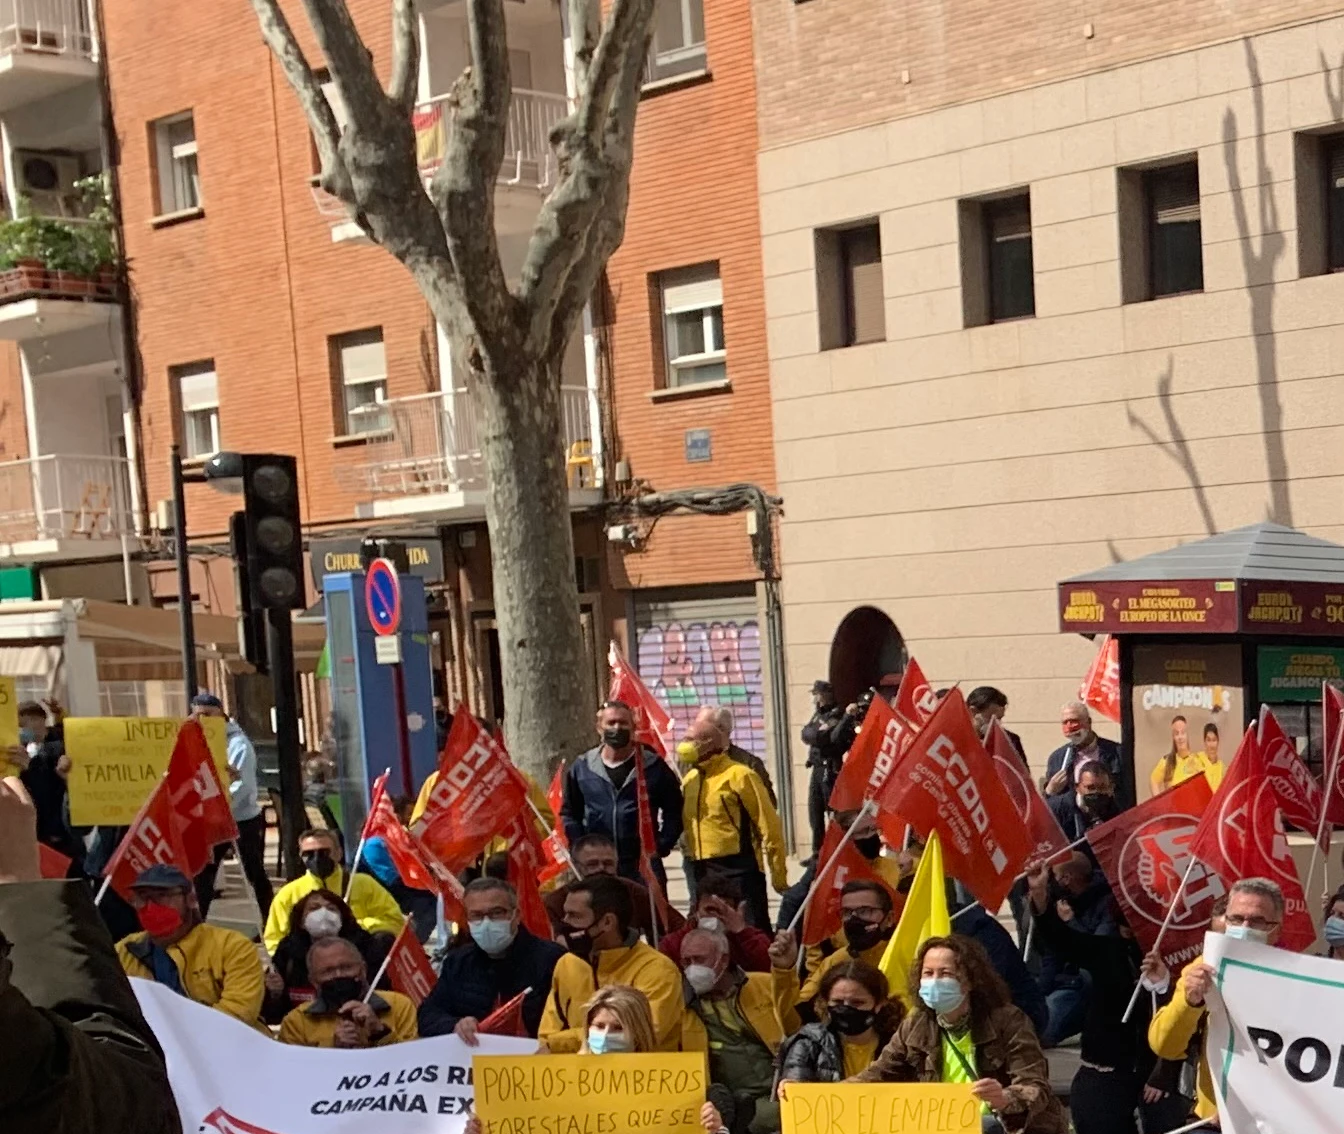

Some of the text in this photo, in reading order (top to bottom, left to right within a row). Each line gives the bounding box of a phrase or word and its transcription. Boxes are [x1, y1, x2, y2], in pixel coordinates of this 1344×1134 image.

[405, 547, 429, 565] IDA
[83, 762, 157, 784] FAMILIA
[926, 733, 990, 834] CCOO
[336, 1073, 372, 1092] NO
[373, 1071, 391, 1088] A
[394, 1064, 440, 1086] LOS
[310, 1088, 431, 1116] CAMPAÑA
[889, 1096, 977, 1134] EMPLEO
[627, 1108, 665, 1128] QUE
[668, 1108, 695, 1127] SE
